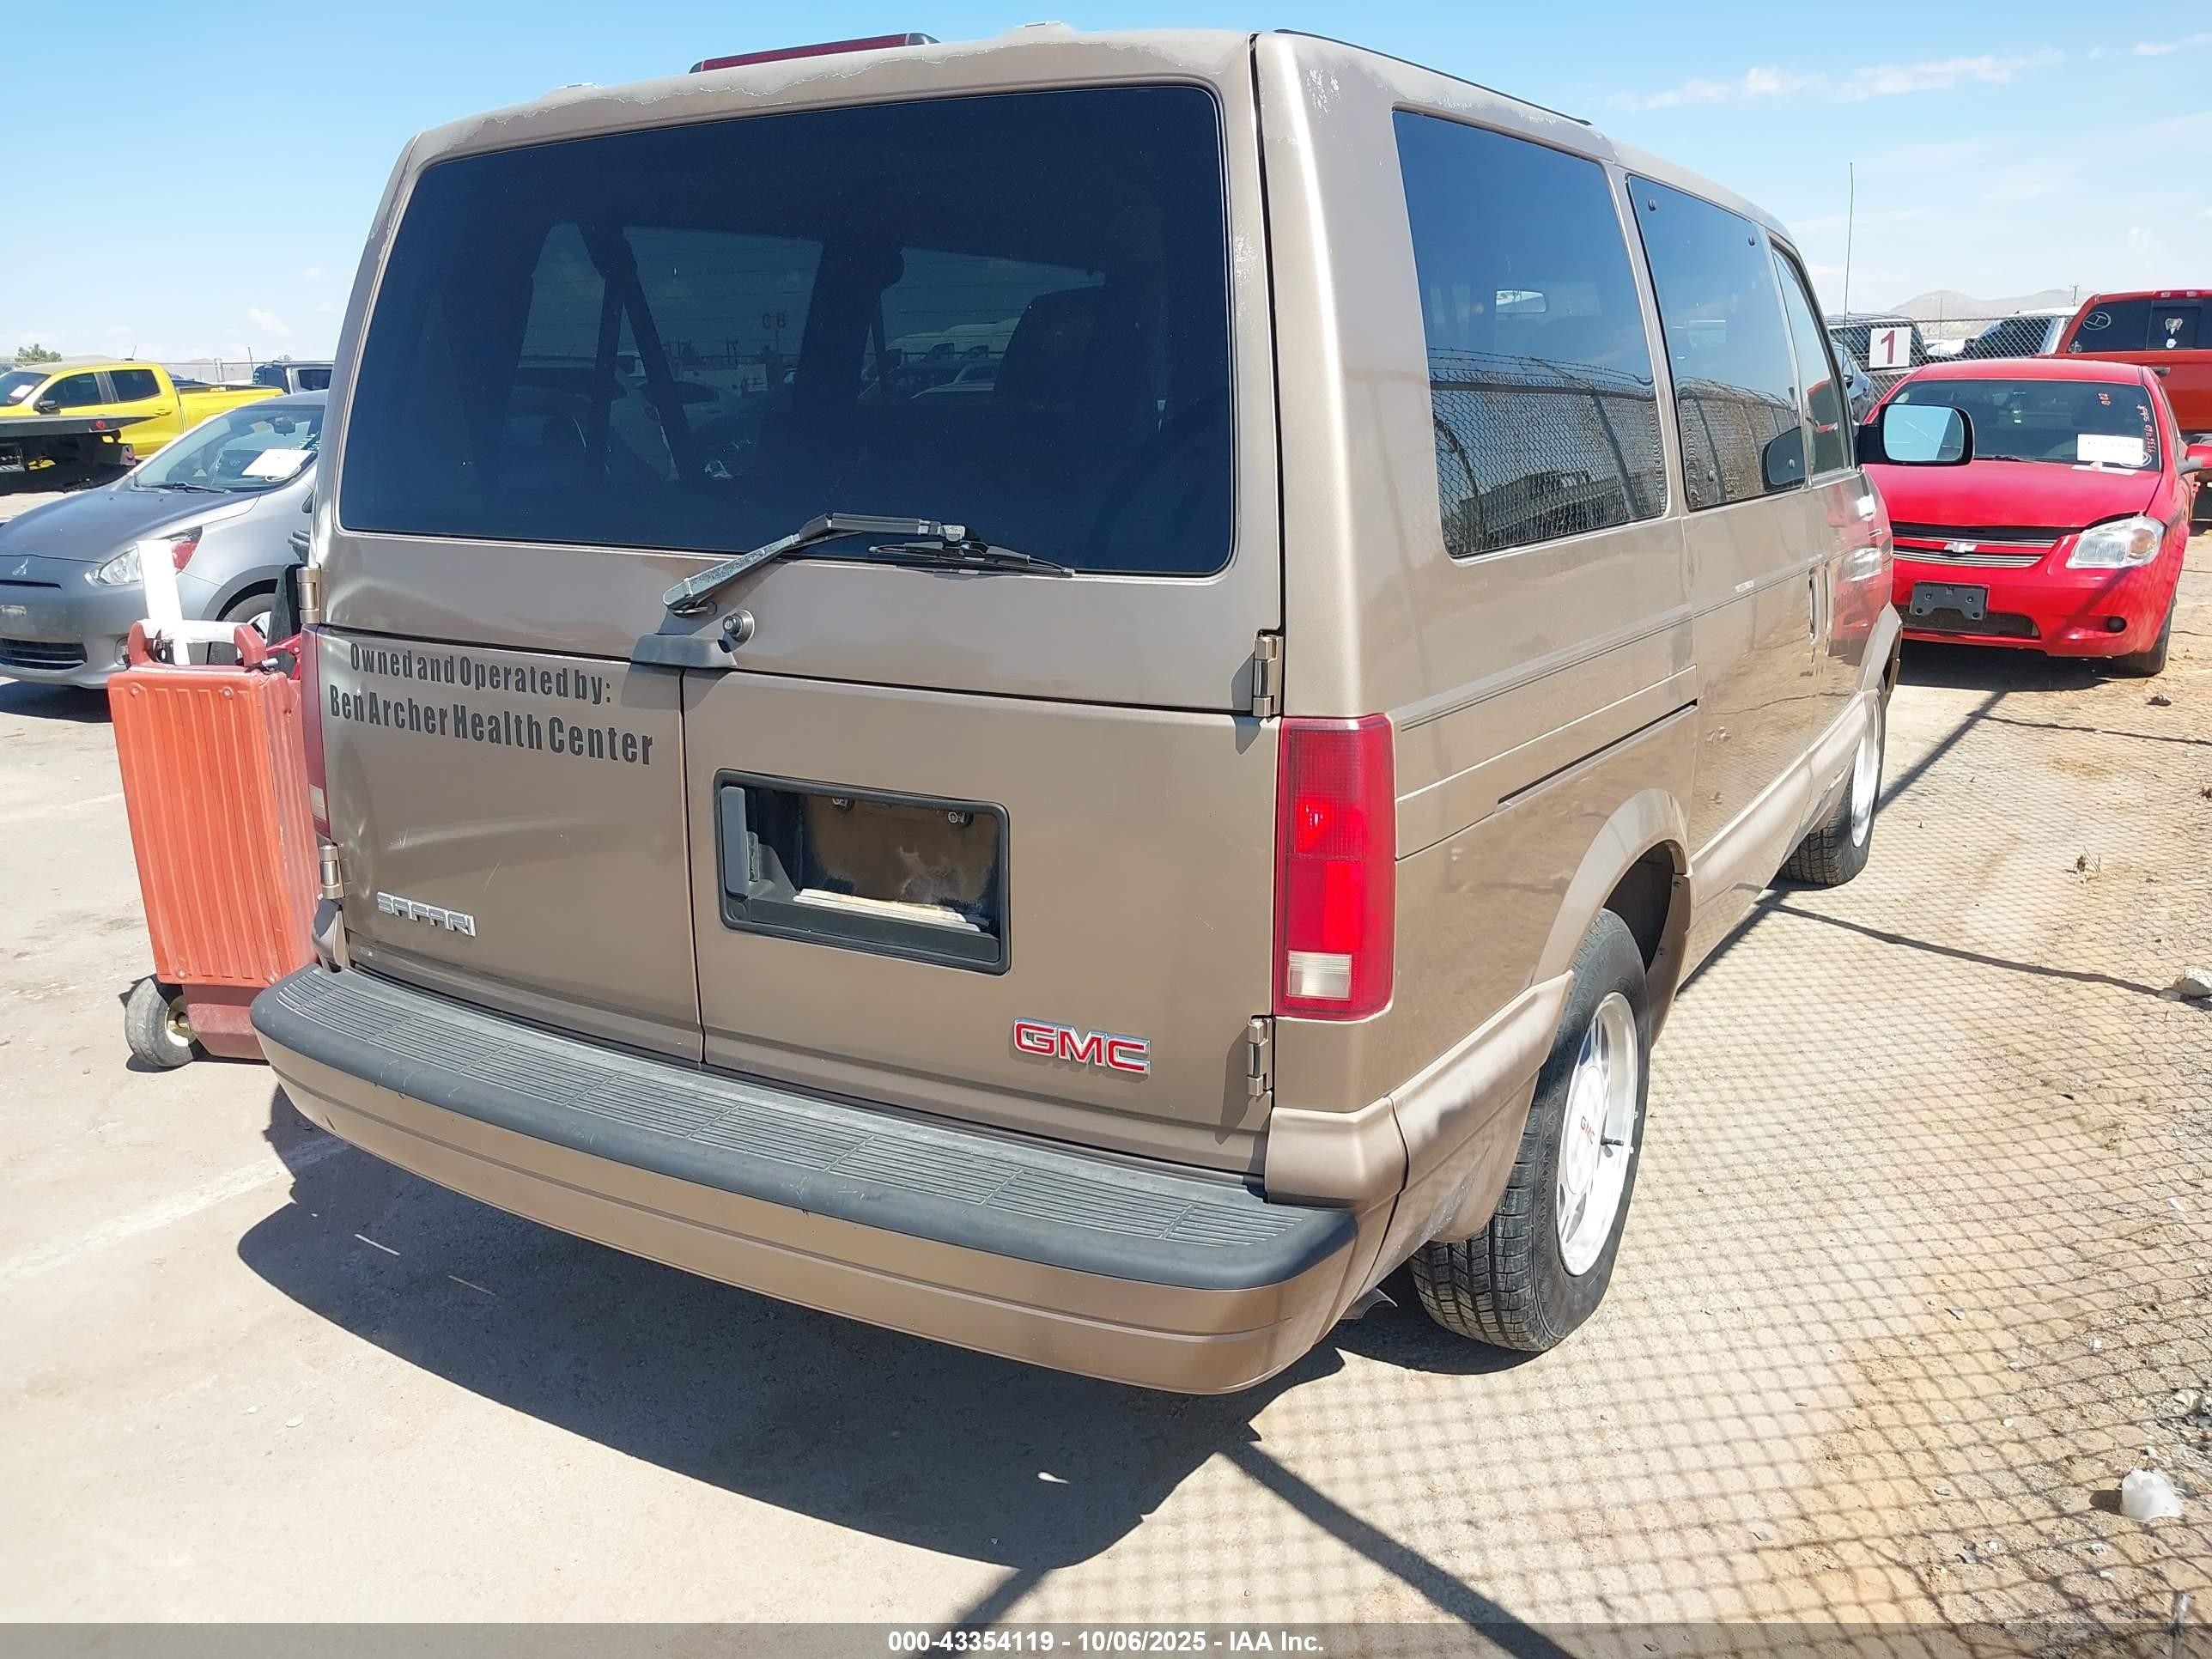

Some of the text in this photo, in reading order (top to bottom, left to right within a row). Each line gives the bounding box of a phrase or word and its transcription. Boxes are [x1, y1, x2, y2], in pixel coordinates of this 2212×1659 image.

[1880, 330, 1895, 364] 1
[350, 642, 611, 705] Owned and Operated by:
[329, 684, 653, 765] Ben Archer Health Center
[376, 890, 477, 938] SAFARI
[1013, 1018, 1151, 1074] GMC
[1580, 1115, 1595, 1146] GMC
